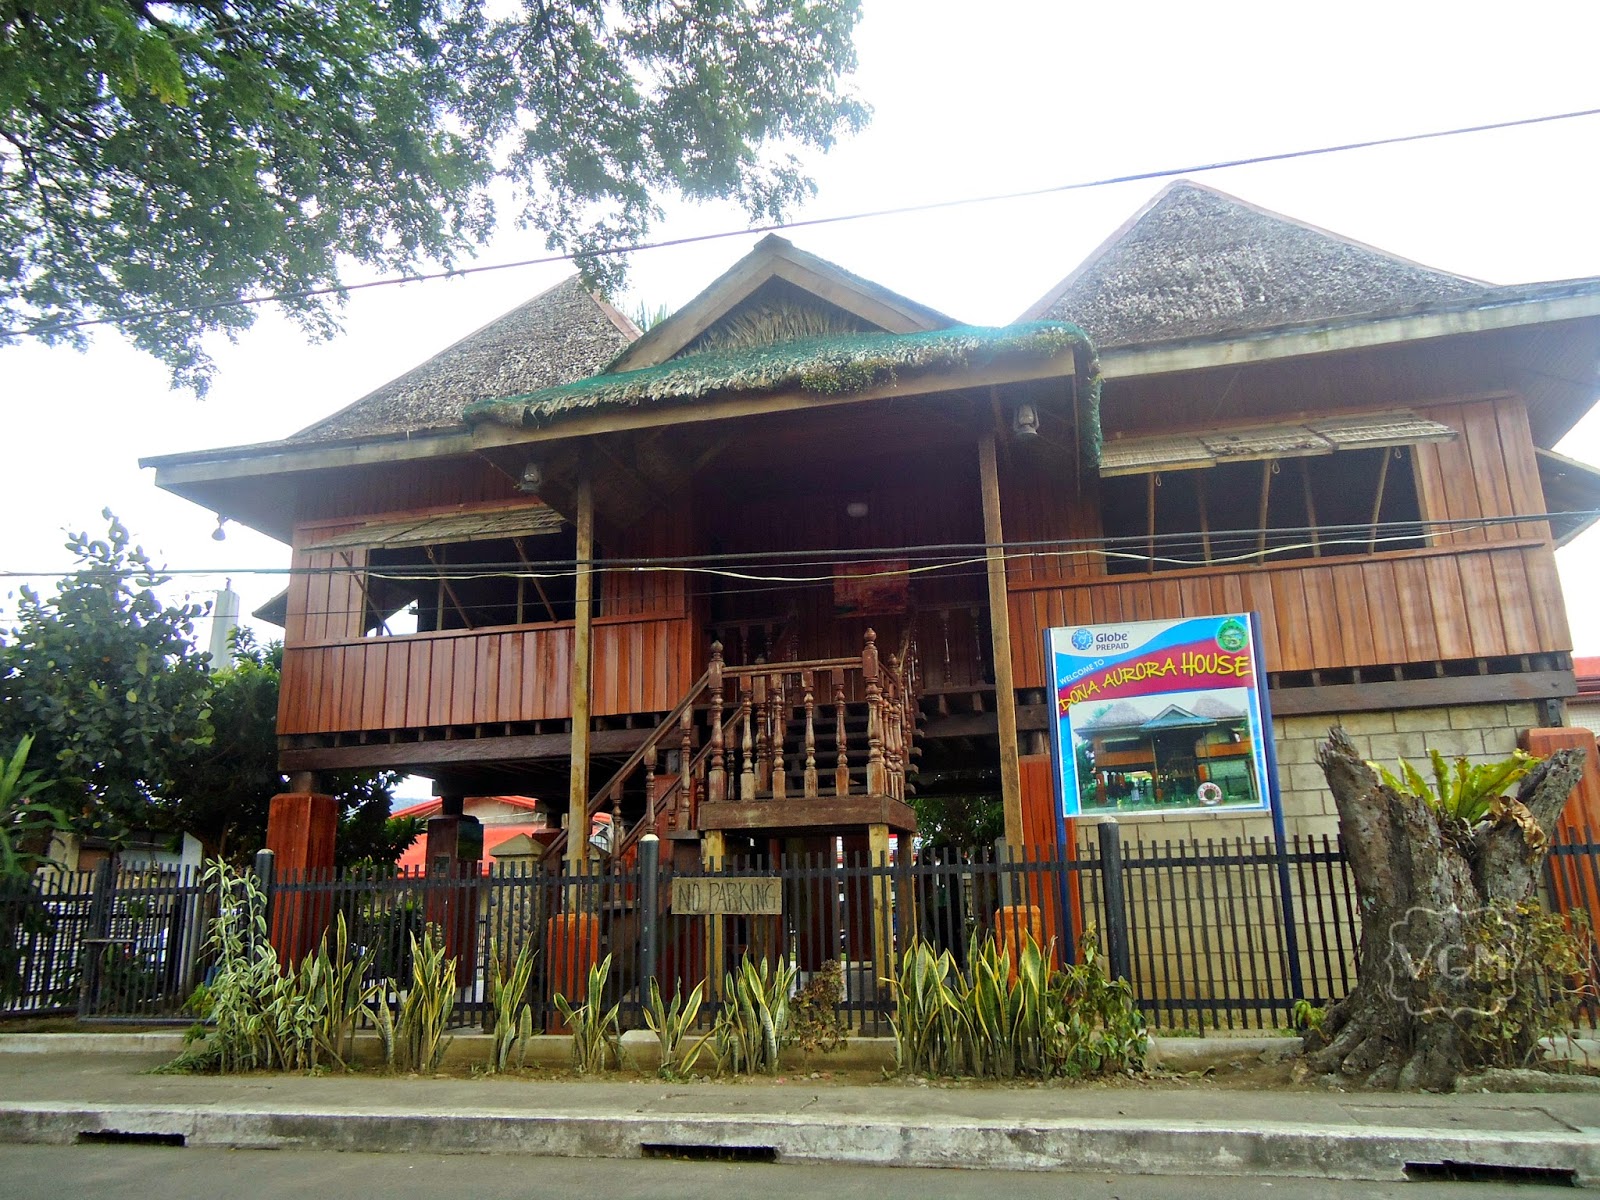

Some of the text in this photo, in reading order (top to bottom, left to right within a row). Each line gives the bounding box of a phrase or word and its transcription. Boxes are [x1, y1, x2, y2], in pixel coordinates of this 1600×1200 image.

[1095, 632, 1128, 643] Globe
[1096, 642, 1129, 651] PREPAID
[1059, 659, 1104, 684] WELCOME TO
[1059, 651, 1252, 711] DOÑA AURORA HOUSE
[678, 882, 776, 912] NO PARKING
